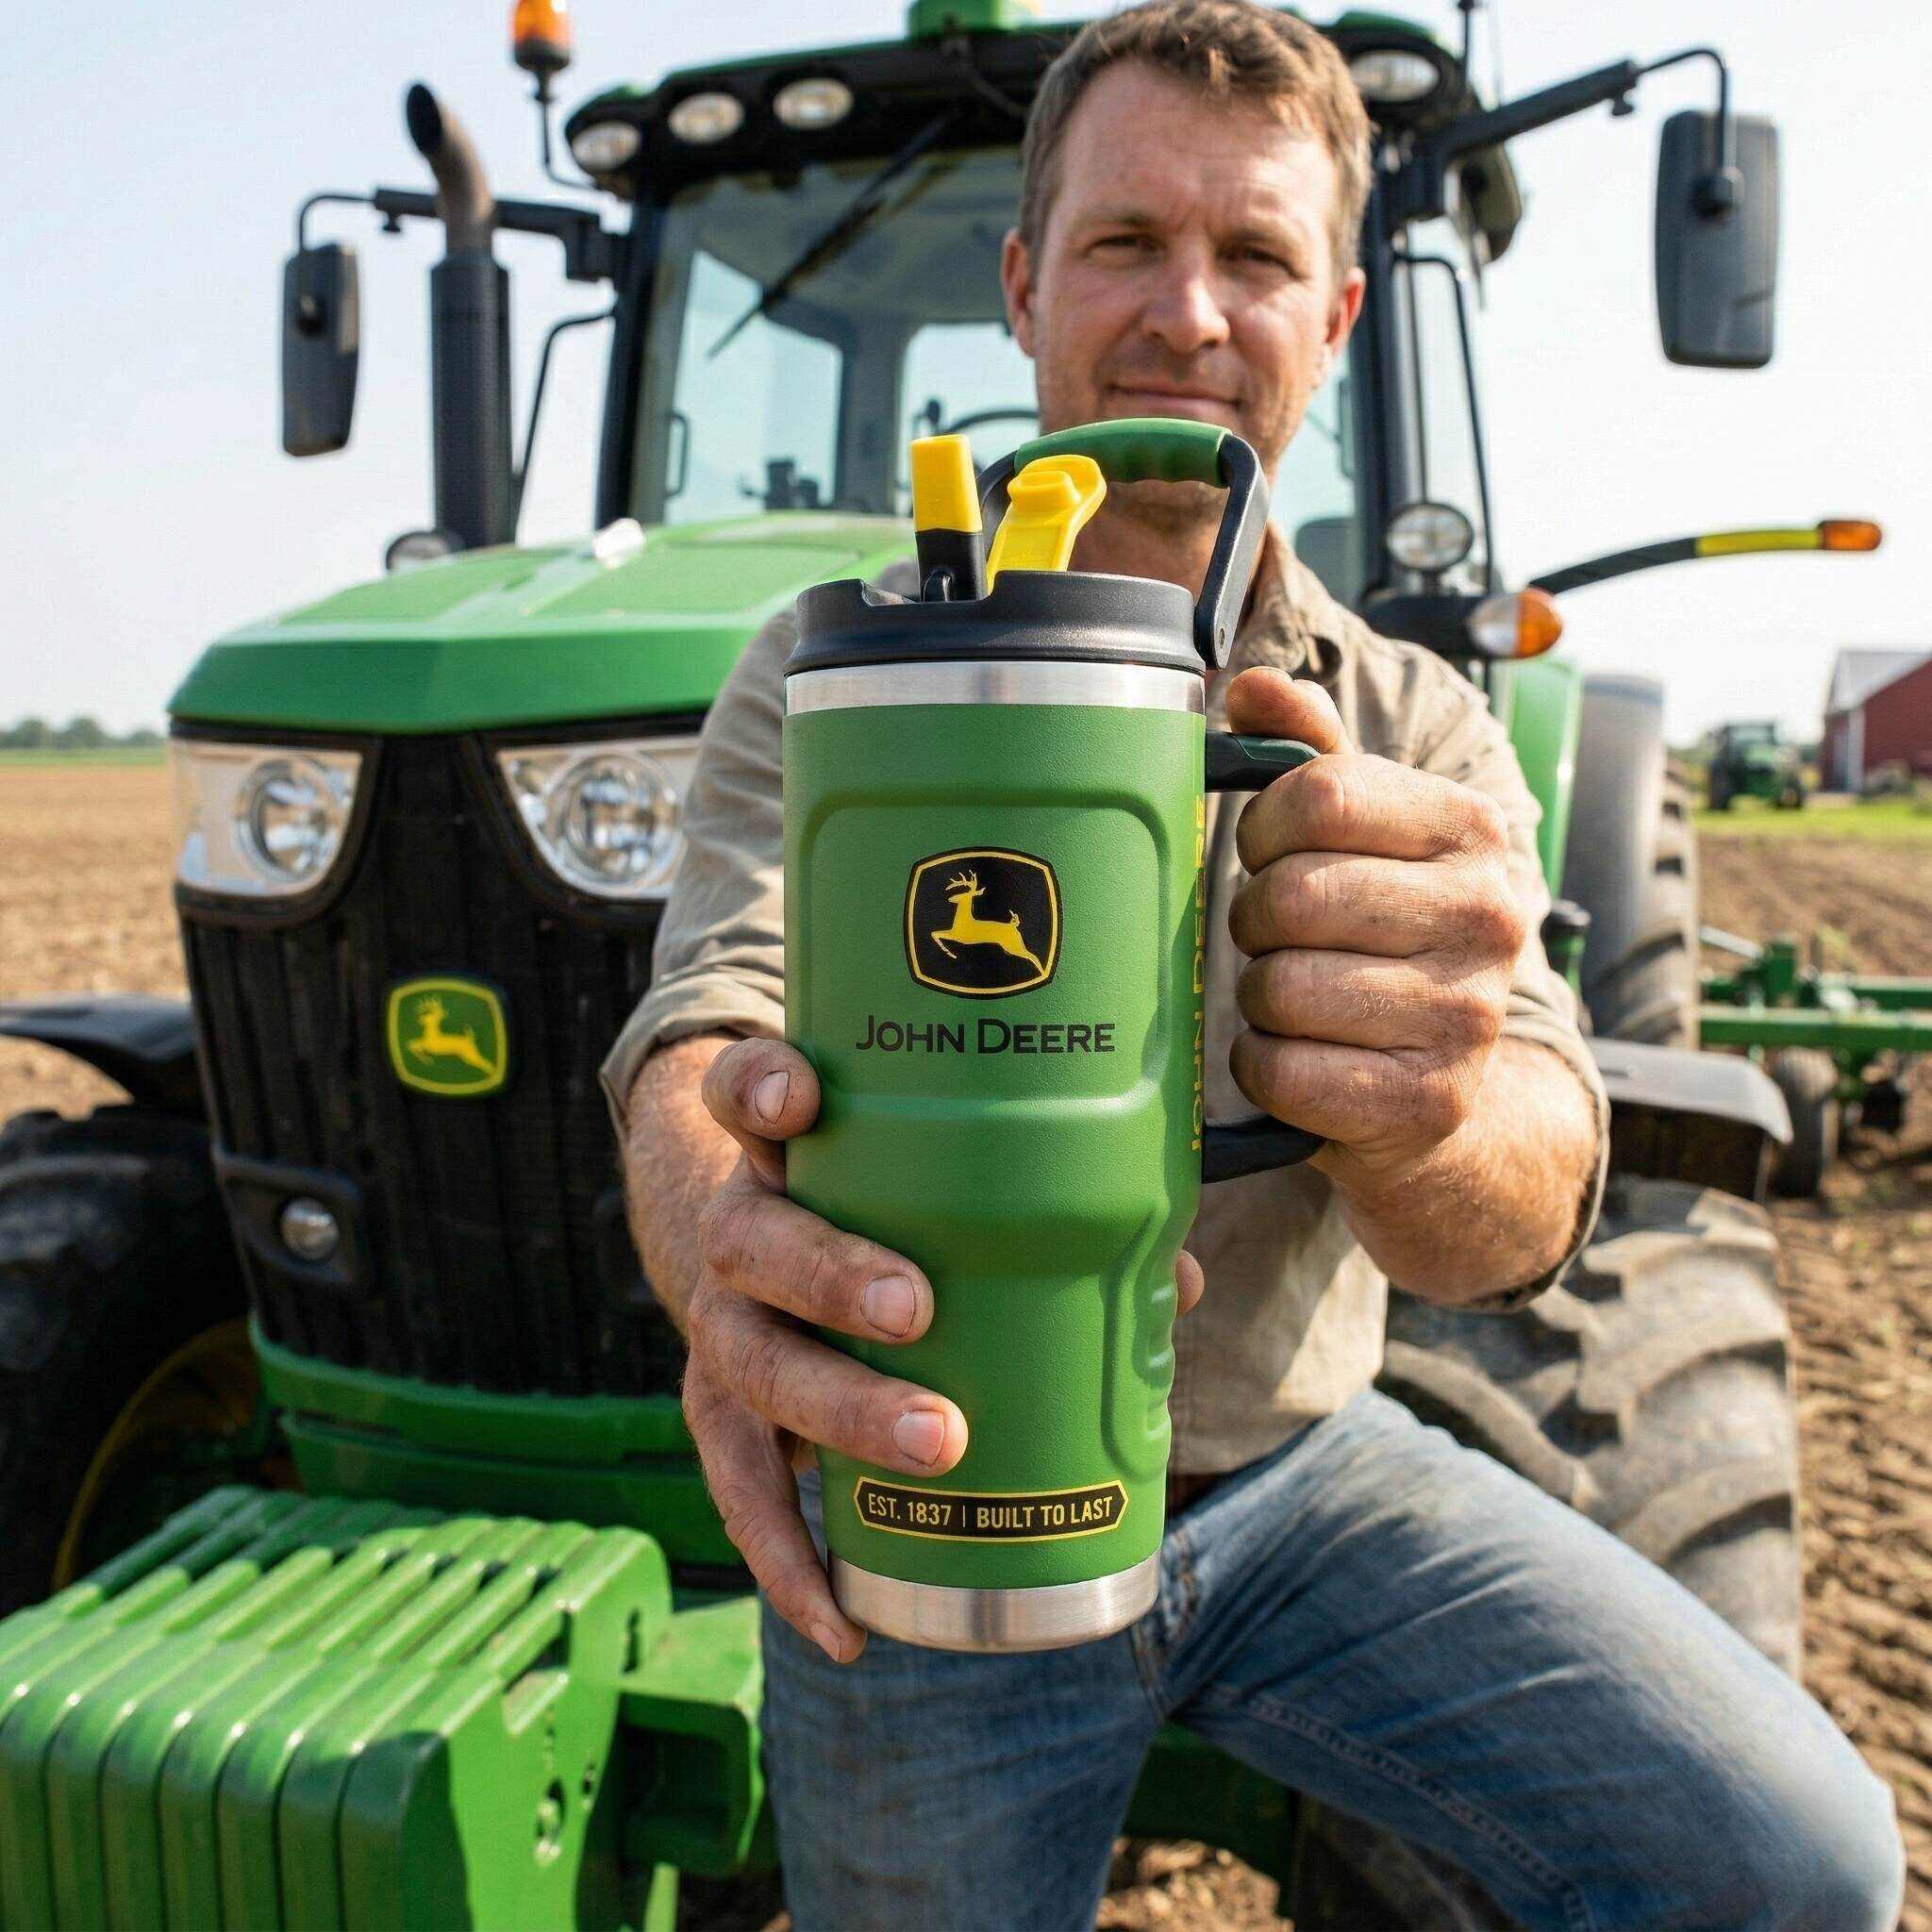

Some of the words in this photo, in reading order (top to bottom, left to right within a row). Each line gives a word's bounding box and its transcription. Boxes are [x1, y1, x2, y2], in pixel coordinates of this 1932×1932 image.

[856, 1014, 965, 1054] JOHN
[977, 1018, 1116, 1055] DEERE
[868, 1492, 901, 1520] EST.
[907, 1501, 953, 1526] 1837
[976, 1506, 1035, 1529] BUILT
[1041, 1504, 1065, 1527] TO
[1071, 1496, 1113, 1524] LAST
